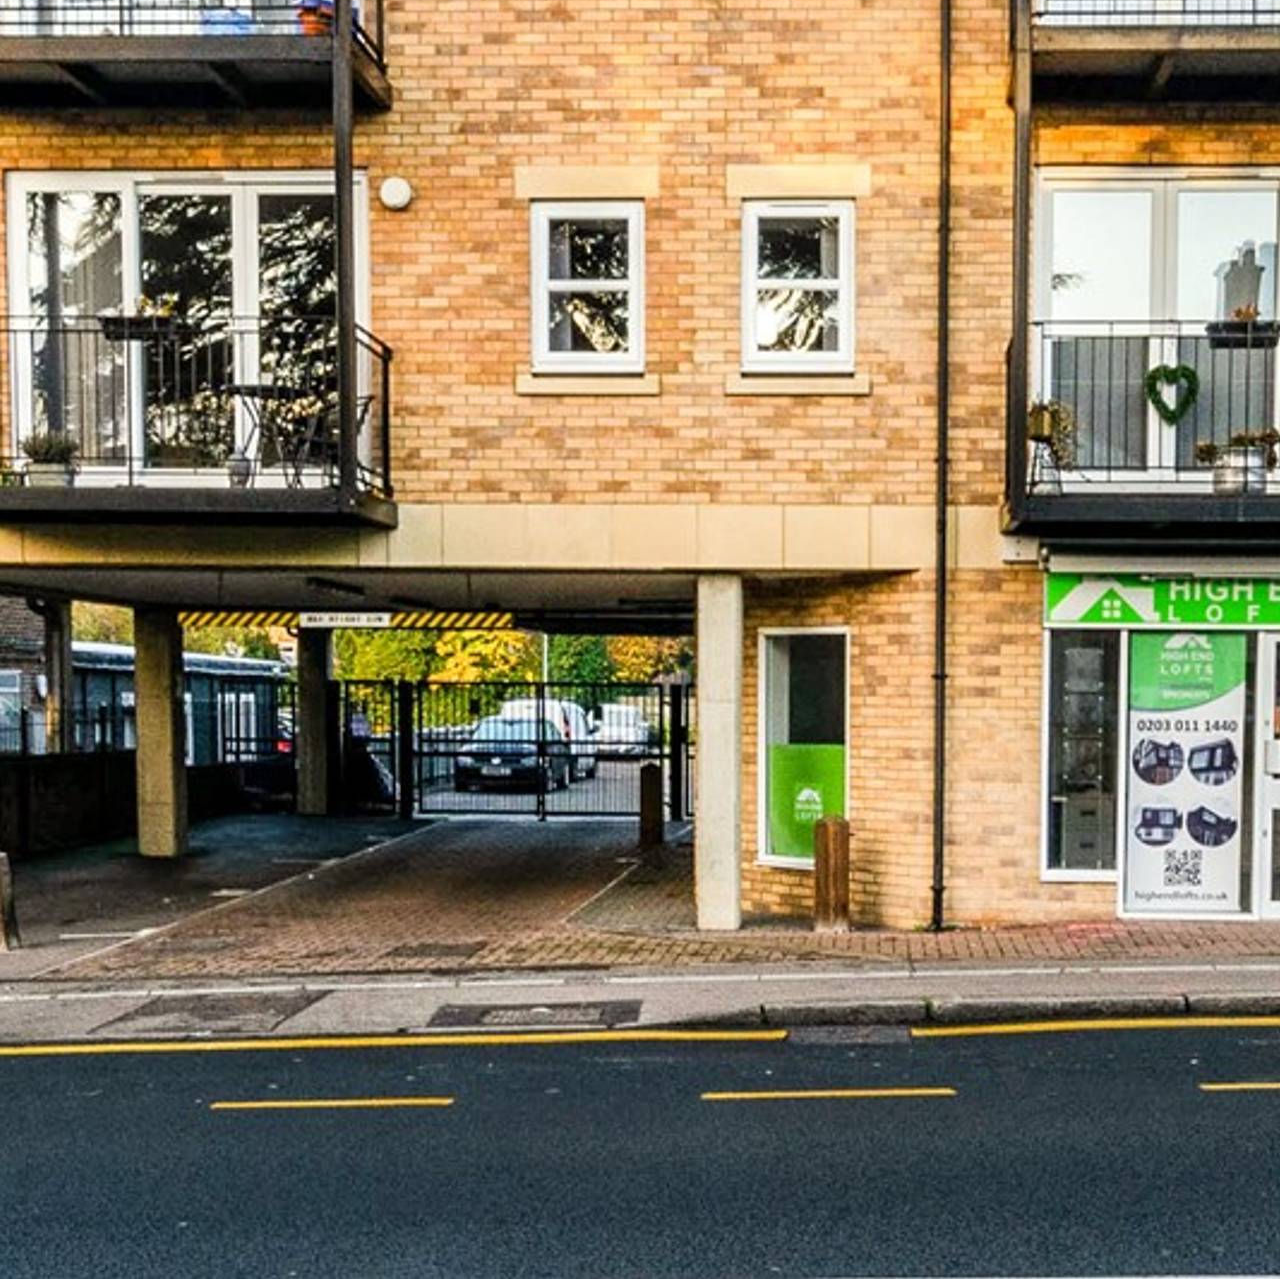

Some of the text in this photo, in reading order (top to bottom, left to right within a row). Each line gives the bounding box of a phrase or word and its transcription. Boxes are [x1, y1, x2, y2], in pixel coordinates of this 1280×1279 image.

[1169, 579, 1254, 602] HIGH
[1136, 719, 1238, 733] 0203 011 1440
